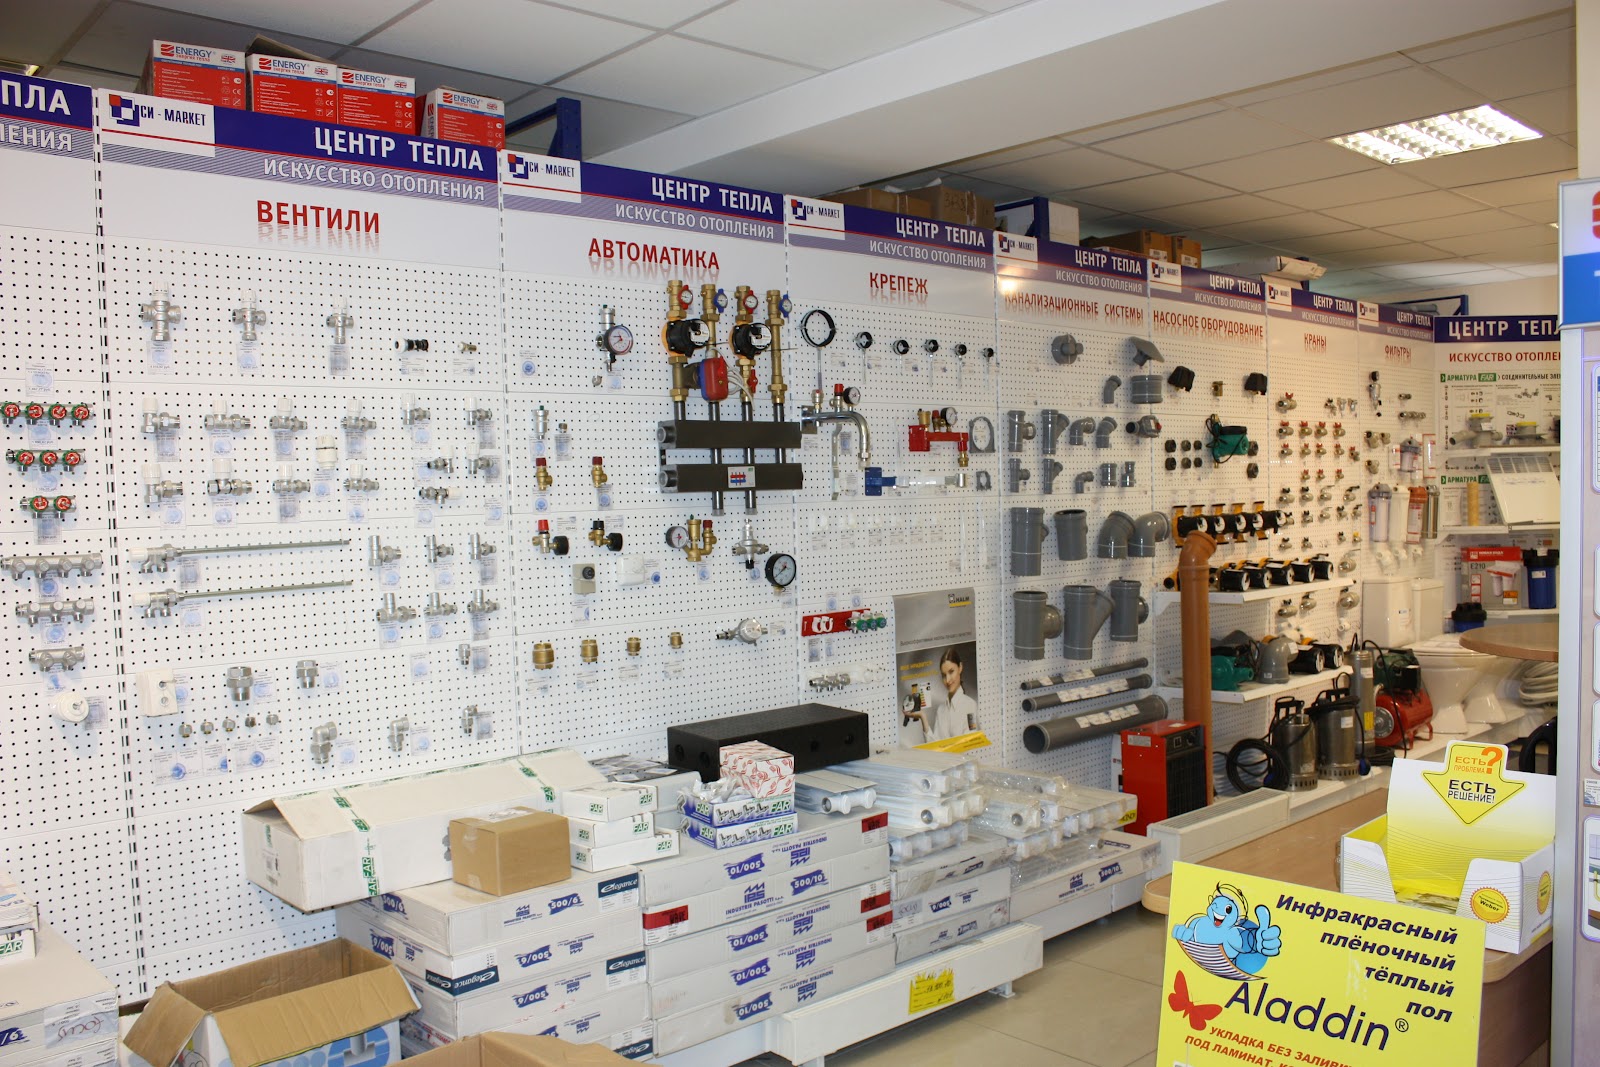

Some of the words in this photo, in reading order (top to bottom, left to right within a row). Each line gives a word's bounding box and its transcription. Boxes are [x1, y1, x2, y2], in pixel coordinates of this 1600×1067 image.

[175, 46, 212, 59] ENERGY
[272, 59, 306, 71] ENERGY
[355, 73, 387, 84] ENERGY
[453, 94, 481, 106] ENERGY
[315, 127, 396, 158] ЦЕНТР
[408, 140, 484, 171] ТЕПЛА
[263, 158, 376, 187] ИСКУССТВО
[381, 173, 484, 200] ОТОПЛЕНИЯ
[652, 177, 710, 203] ЦЕНТР
[718, 188, 774, 215] ТЕПЛА
[257, 200, 380, 234] ВЕНТИЛИ
[615, 203, 696, 228] ИСКУССТВО
[700, 216, 775, 240] ОТОПЛЕНИЯ
[896, 217, 939, 239] ЦЕНТР
[945, 226, 986, 248] ТЕПЛА
[588, 238, 720, 270] АВТОМАТИКА
[869, 240, 928, 260] ИСКУССТВО
[931, 250, 986, 269] ОТОПЛЕНИЯ
[1075, 249, 1107, 268] ЦЕНТР
[1111, 256, 1142, 275] ТЕПЛА
[869, 272, 928, 295] КРЕПЕЖ
[1056, 269, 1100, 287] ИСКУССТВО
[1101, 276, 1143, 293] ОТОПЛЕНИЯ
[1209, 274, 1235, 293] ЦЕНТР
[1238, 280, 1262, 296] ТЕПЛА
[1005, 291, 1099, 314] КАНАЛИЗАЦИОННЫЕ
[1104, 303, 1144, 319] СИСТЕМЫ
[1194, 292, 1229, 308] ИСКУССТВО
[1229, 297, 1262, 312] ОТОПЛЕНИЯ
[1313, 294, 1333, 309] ЦЕНТР
[1335, 299, 1354, 313] ТЕПЛА
[1153, 310, 1199, 331] НАСОСНОЕ
[1201, 317, 1264, 340] ОБОРУДОВАНИЕ
[1301, 311, 1328, 324] ИСКУССТВО
[1328, 315, 1355, 328] ОТОПЛЕНИЯ
[1396, 310, 1414, 323] ЦЕНТР
[1415, 314, 1431, 327] ТЕПЛА
[1448, 321, 1508, 340] ЦЕНТР
[1304, 333, 1326, 347] КРАНЫ
[1384, 344, 1411, 359] ФИЛЬТРЫ
[1449, 352, 1512, 363] ИСКУССТВО
[1447, 475, 1477, 483] АРМАТУРА
[1455, 756, 1486, 766] ЕСТЬ
[1453, 765, 1486, 774] ПРОБЛЕМА
[1449, 779, 1497, 794] ЕСТЬ
[639, 794, 653, 805] FAR
[1447, 791, 1495, 804] РЕШЕНИЕ!
[589, 803, 603, 814] FAR
[696, 803, 710, 815] FAR
[771, 800, 791, 812] FAR
[633, 821, 649, 833] FAR
[700, 827, 714, 839] FAR
[773, 823, 793, 836] FAR
[578, 829, 589, 840] FAR
[656, 839, 672, 851] FAR
[781, 842, 802, 852] PASOTTI
[803, 836, 828, 848] INDUSTRIE
[576, 851, 587, 862] FAR
[362, 857, 372, 878] FAR
[730, 860, 762, 876] 500/10
[1100, 864, 1119, 877] 500/10
[794, 874, 824, 888] 500/10
[383, 895, 404, 911] 500/6
[550, 896, 579, 909] 500/6
[725, 904, 752, 916] INDUSTRIE
[753, 896, 774, 908] PASOTTI
[1479, 899, 1500, 912] Weber
[809, 904, 831, 916] INDUSTRIE
[785, 912, 808, 923] PASOTTI
[1275, 893, 1459, 946] Инфракрасный
[373, 938, 393, 954] 500/6
[733, 933, 765, 947] 500/10
[810, 937, 833, 948] INDUSTRIE
[787, 946, 810, 956] PASOTTI
[1319, 927, 1456, 972] плёночный
[521, 951, 549, 965] 500/6
[736, 966, 767, 981] 500/10
[811, 970, 834, 981] INDUSTRIE
[1365, 963, 1455, 998] тёплый
[789, 979, 811, 989] PASOTTI
[518, 990, 546, 1003] 500/6
[738, 1000, 769, 1016] 500/10
[1405, 998, 1453, 1024] пол
[1185, 1035, 1210, 1051] ПОД
[1209, 1026, 1264, 1049] УКЛАДКА
[1267, 1043, 1292, 1057] БЕЗ
